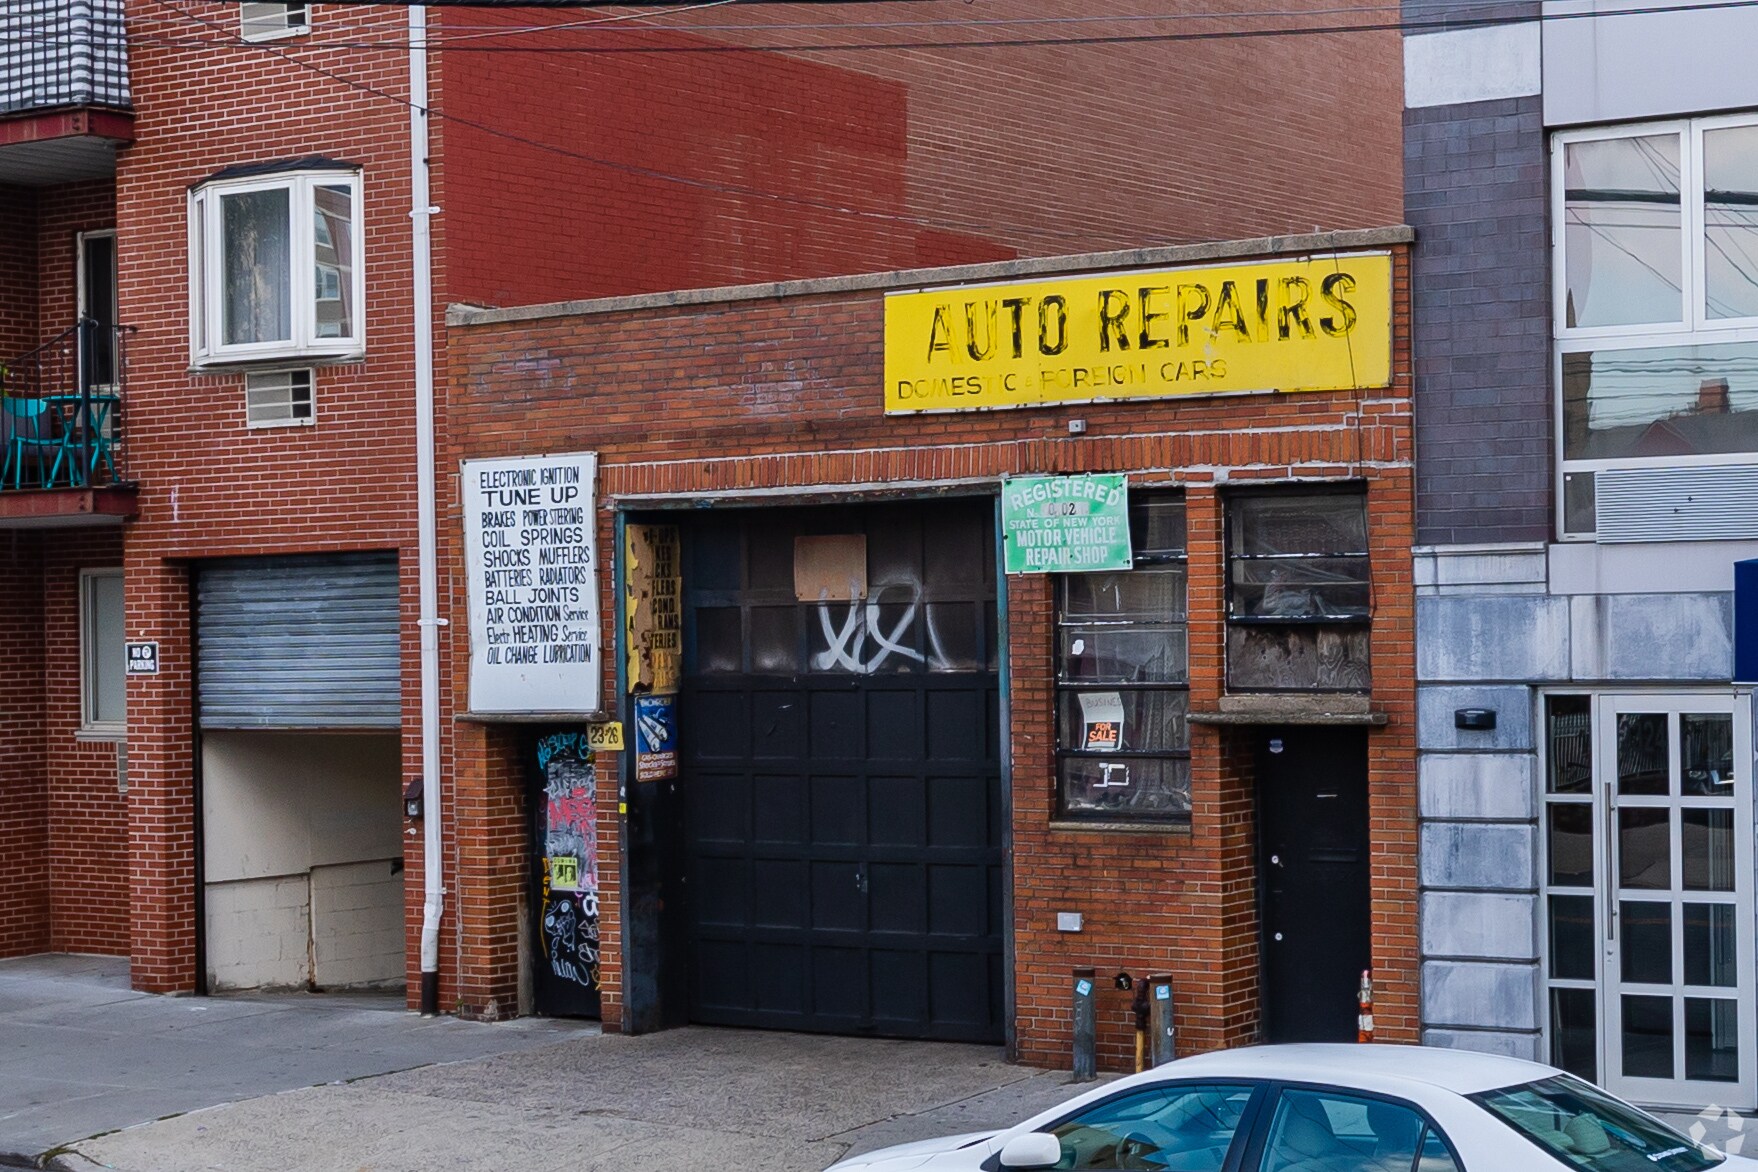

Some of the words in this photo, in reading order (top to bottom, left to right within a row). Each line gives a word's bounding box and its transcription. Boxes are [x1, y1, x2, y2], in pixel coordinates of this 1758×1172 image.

[928, 295, 1069, 364] AUTO
[1099, 272, 1357, 352] REPAIRS
[1160, 359, 1227, 382] CARS
[481, 469, 537, 489] ELECTRONIC
[540, 466, 580, 485] IGNITION
[481, 488, 541, 507] TUNE
[551, 486, 578, 503] UP
[1010, 480, 1120, 511] REGISTERED
[482, 510, 516, 528] BRAKES
[523, 509, 548, 527] POWER
[549, 507, 584, 525] STEERING
[1009, 519, 1039, 530] STATE
[1044, 518, 1059, 529] OF
[1063, 517, 1088, 528] NEW
[1092, 516, 1121, 526] YORK
[482, 530, 511, 548] COIL
[520, 527, 583, 546] SPRINGS
[1016, 529, 1061, 547] MOTOR
[1064, 526, 1117, 545] VEHICLE
[483, 549, 531, 568] SHOCKS
[539, 545, 590, 565] MUFFLERS
[1026, 548, 1070, 566] REPAIR
[1074, 546, 1109, 564] SHOP
[484, 569, 533, 588] BATTERIES
[539, 566, 587, 586] RADIATORS
[485, 590, 522, 606] BALL
[528, 587, 580, 604] JOINTS
[486, 607, 504, 625] AIR
[507, 605, 561, 624] CONDITION
[563, 604, 589, 621] Service
[512, 624, 559, 644] HEATING
[561, 624, 588, 642] Service
[486, 646, 502, 665] OIL
[505, 645, 539, 664] CHANGE
[543, 643, 592, 664] LUBRICATION
[1088, 730, 1118, 742] SALE
[1095, 722, 1112, 731] FOR
